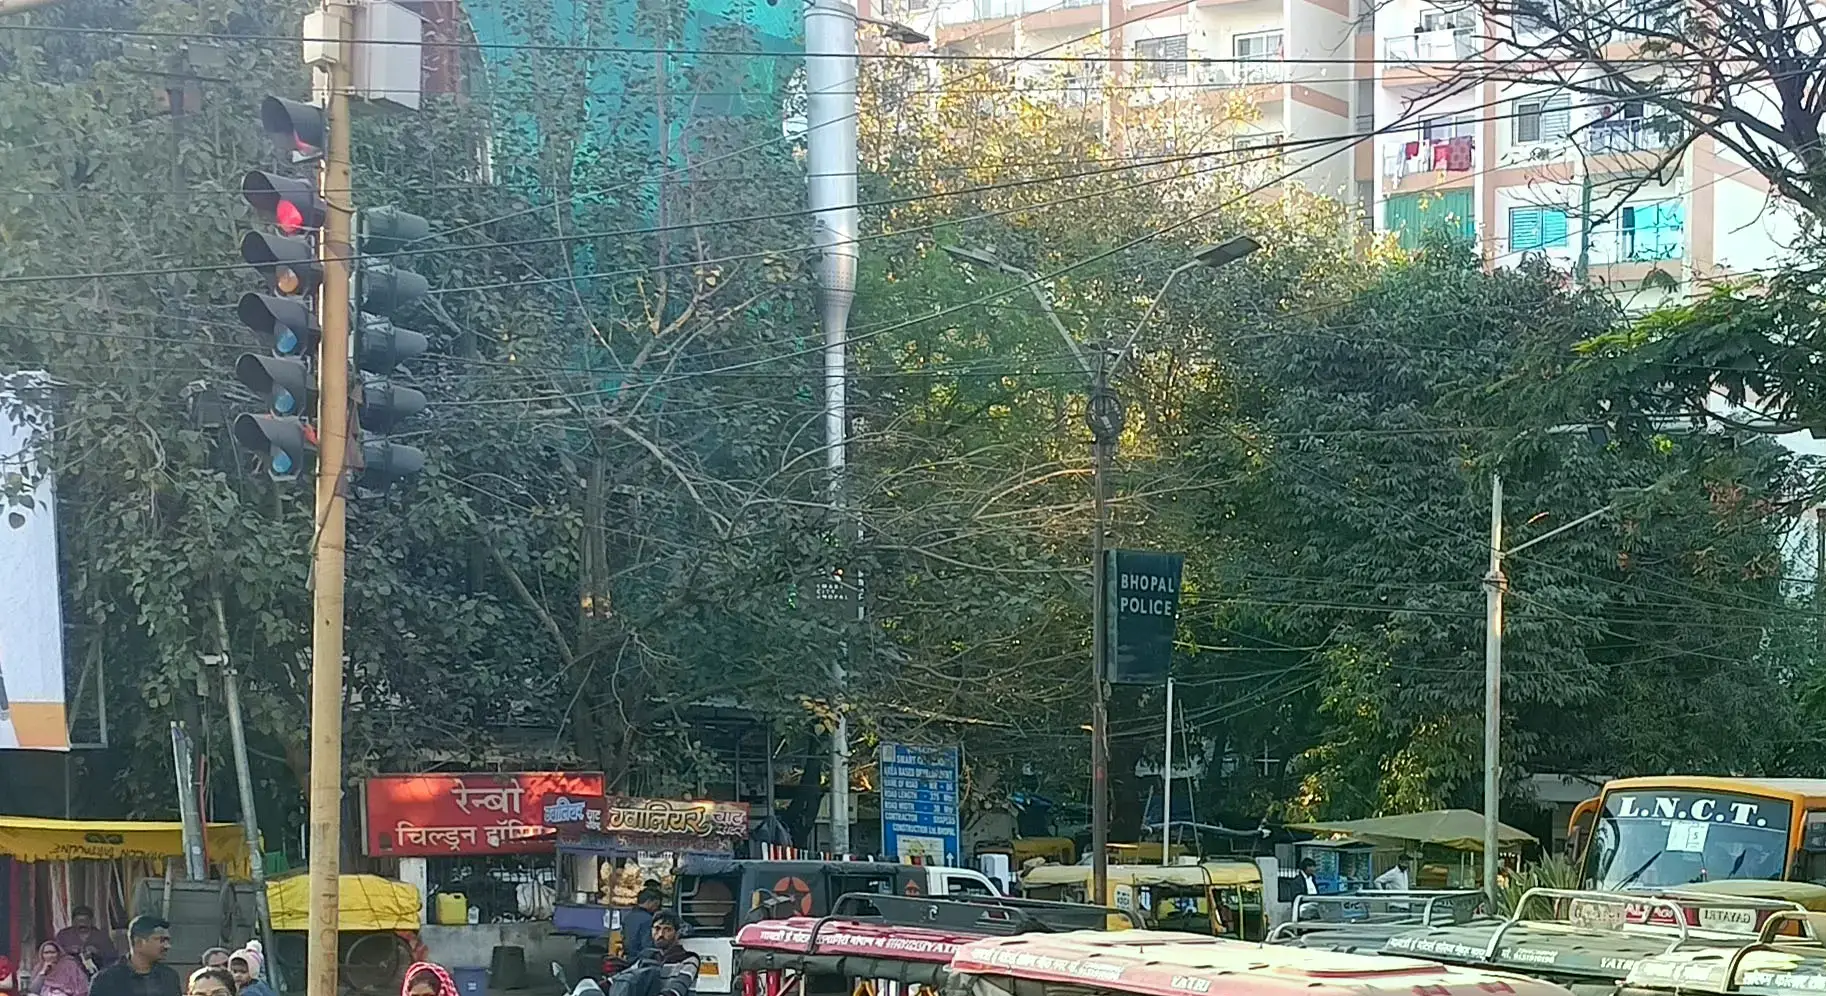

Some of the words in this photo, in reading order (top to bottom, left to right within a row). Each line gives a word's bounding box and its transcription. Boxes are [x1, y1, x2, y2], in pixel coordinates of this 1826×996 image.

[1121, 573, 1174, 593] BHOPAL
[1120, 596, 1172, 616] POLICE
[451, 778, 525, 815] रेन्बो
[1617, 796, 1768, 827] L.N.C.T.
[608, 801, 713, 837] ग्वालियर
